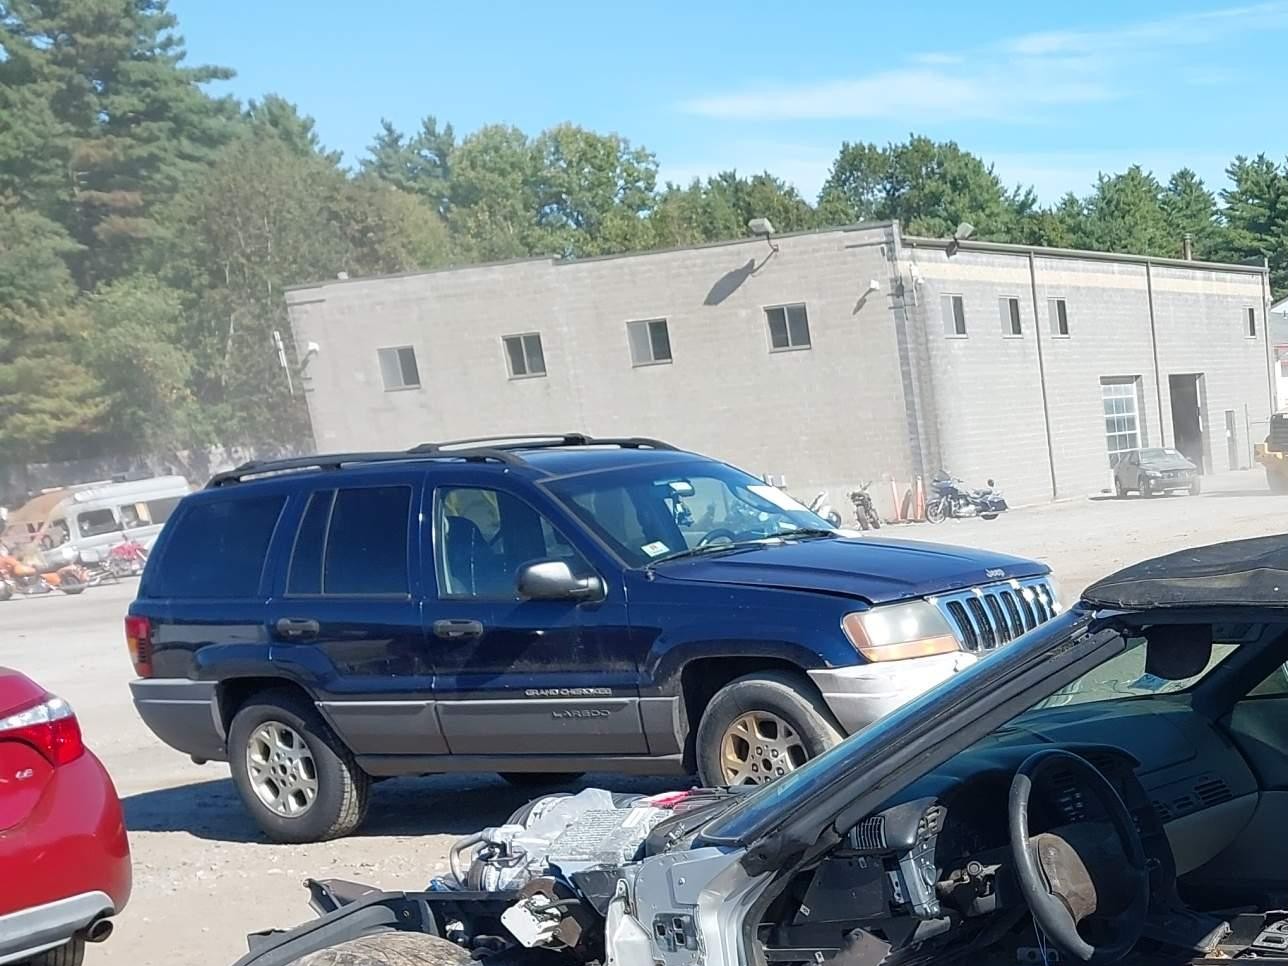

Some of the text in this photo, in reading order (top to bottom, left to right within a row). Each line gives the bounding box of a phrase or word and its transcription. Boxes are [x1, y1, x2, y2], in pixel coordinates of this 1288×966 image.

[984, 568, 1005, 577] Jeep
[525, 687, 613, 696] GRAND CHEROKEE
[552, 709, 611, 718] LAREDO
